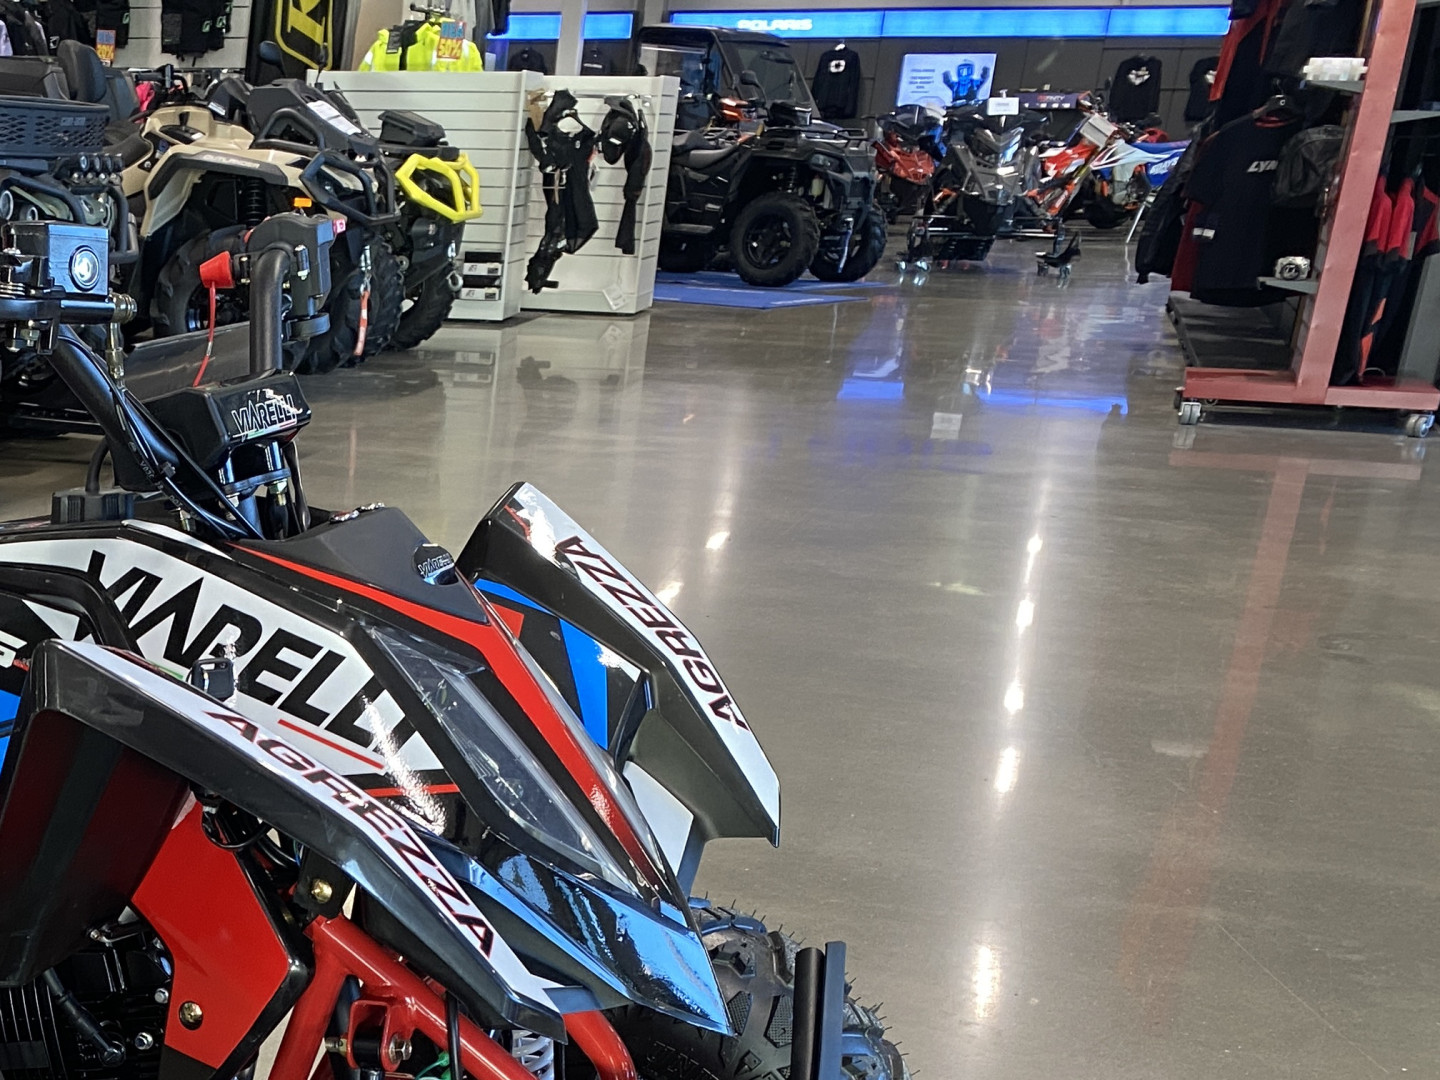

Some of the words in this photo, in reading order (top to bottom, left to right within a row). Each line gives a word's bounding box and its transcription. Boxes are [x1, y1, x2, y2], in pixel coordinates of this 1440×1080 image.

[737, 18, 812, 31] POLARIS
[1246, 160, 1279, 173] LYN
[555, 535, 749, 732] AGREZZA
[202, 710, 496, 960] AGREZZA
